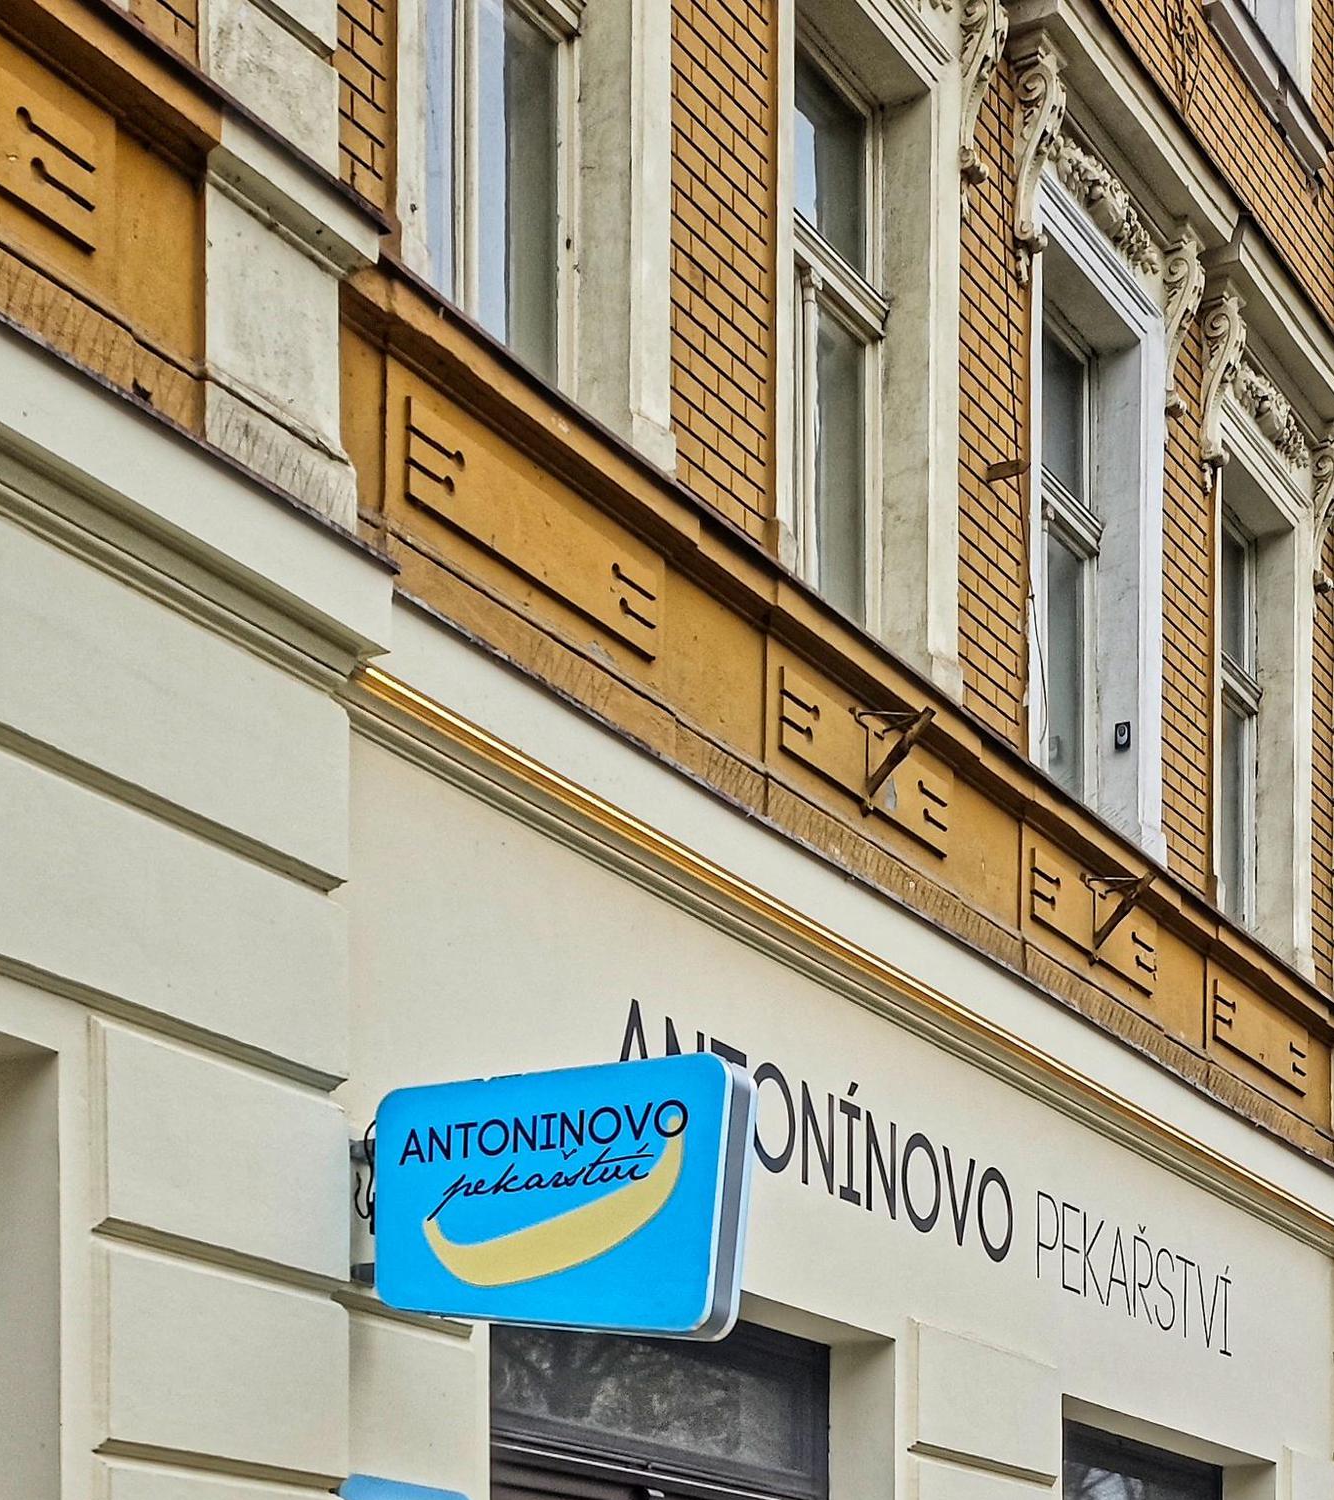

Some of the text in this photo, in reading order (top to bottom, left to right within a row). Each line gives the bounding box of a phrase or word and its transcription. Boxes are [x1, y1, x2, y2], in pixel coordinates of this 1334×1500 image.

[399, 1099, 689, 1166] ANTONINOVO
[619, 998, 1232, 1358] AONÍNOVO PEKAŘSTVÍ
